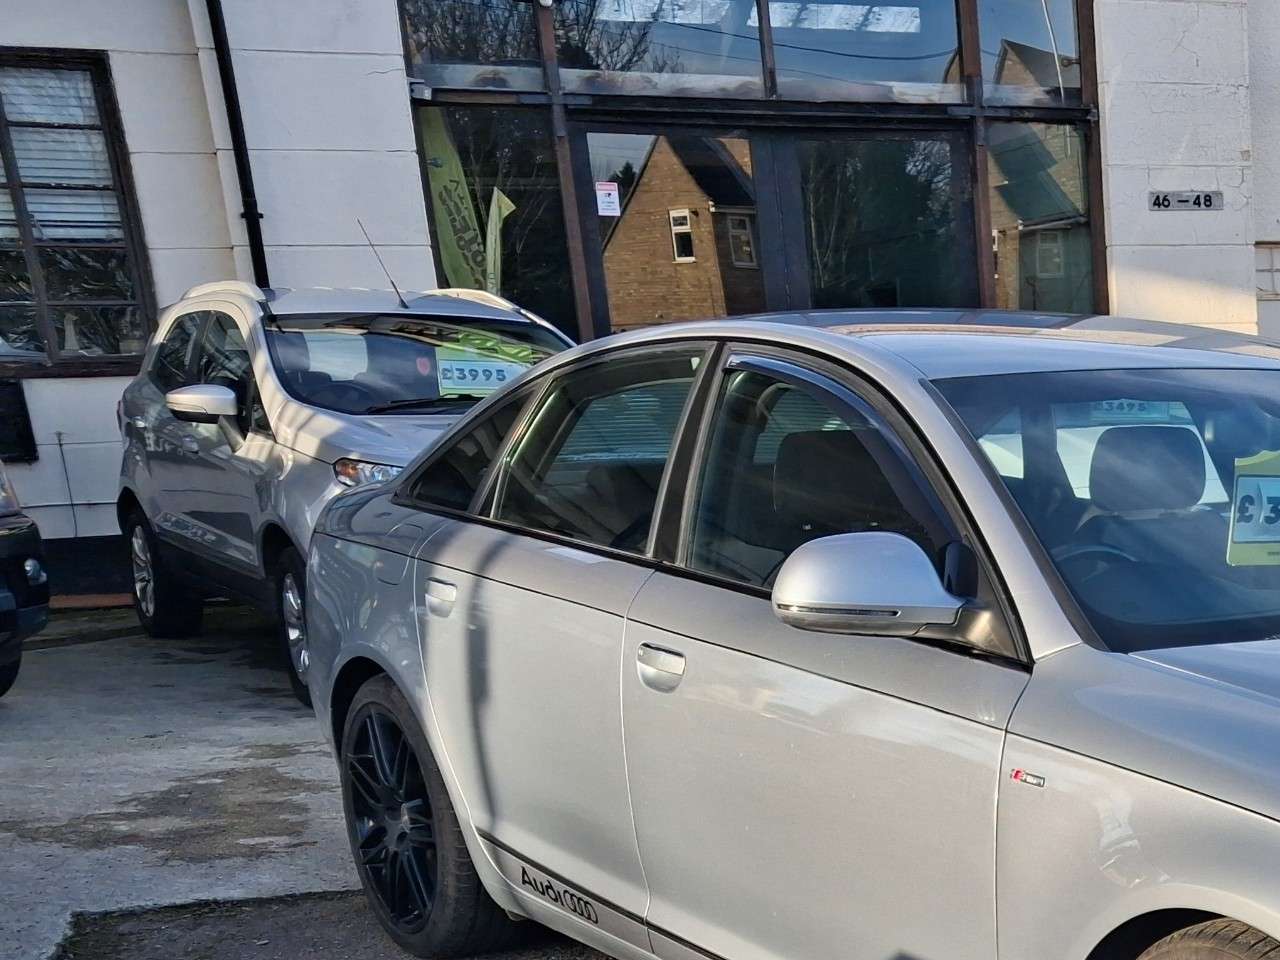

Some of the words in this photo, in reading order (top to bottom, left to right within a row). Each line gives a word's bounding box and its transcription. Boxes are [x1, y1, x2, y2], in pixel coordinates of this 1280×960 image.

[1153, 194, 1171, 209] 46
[1193, 194, 1213, 208] 48
[441, 367, 506, 382] £3995
[520, 866, 564, 906] Audi
